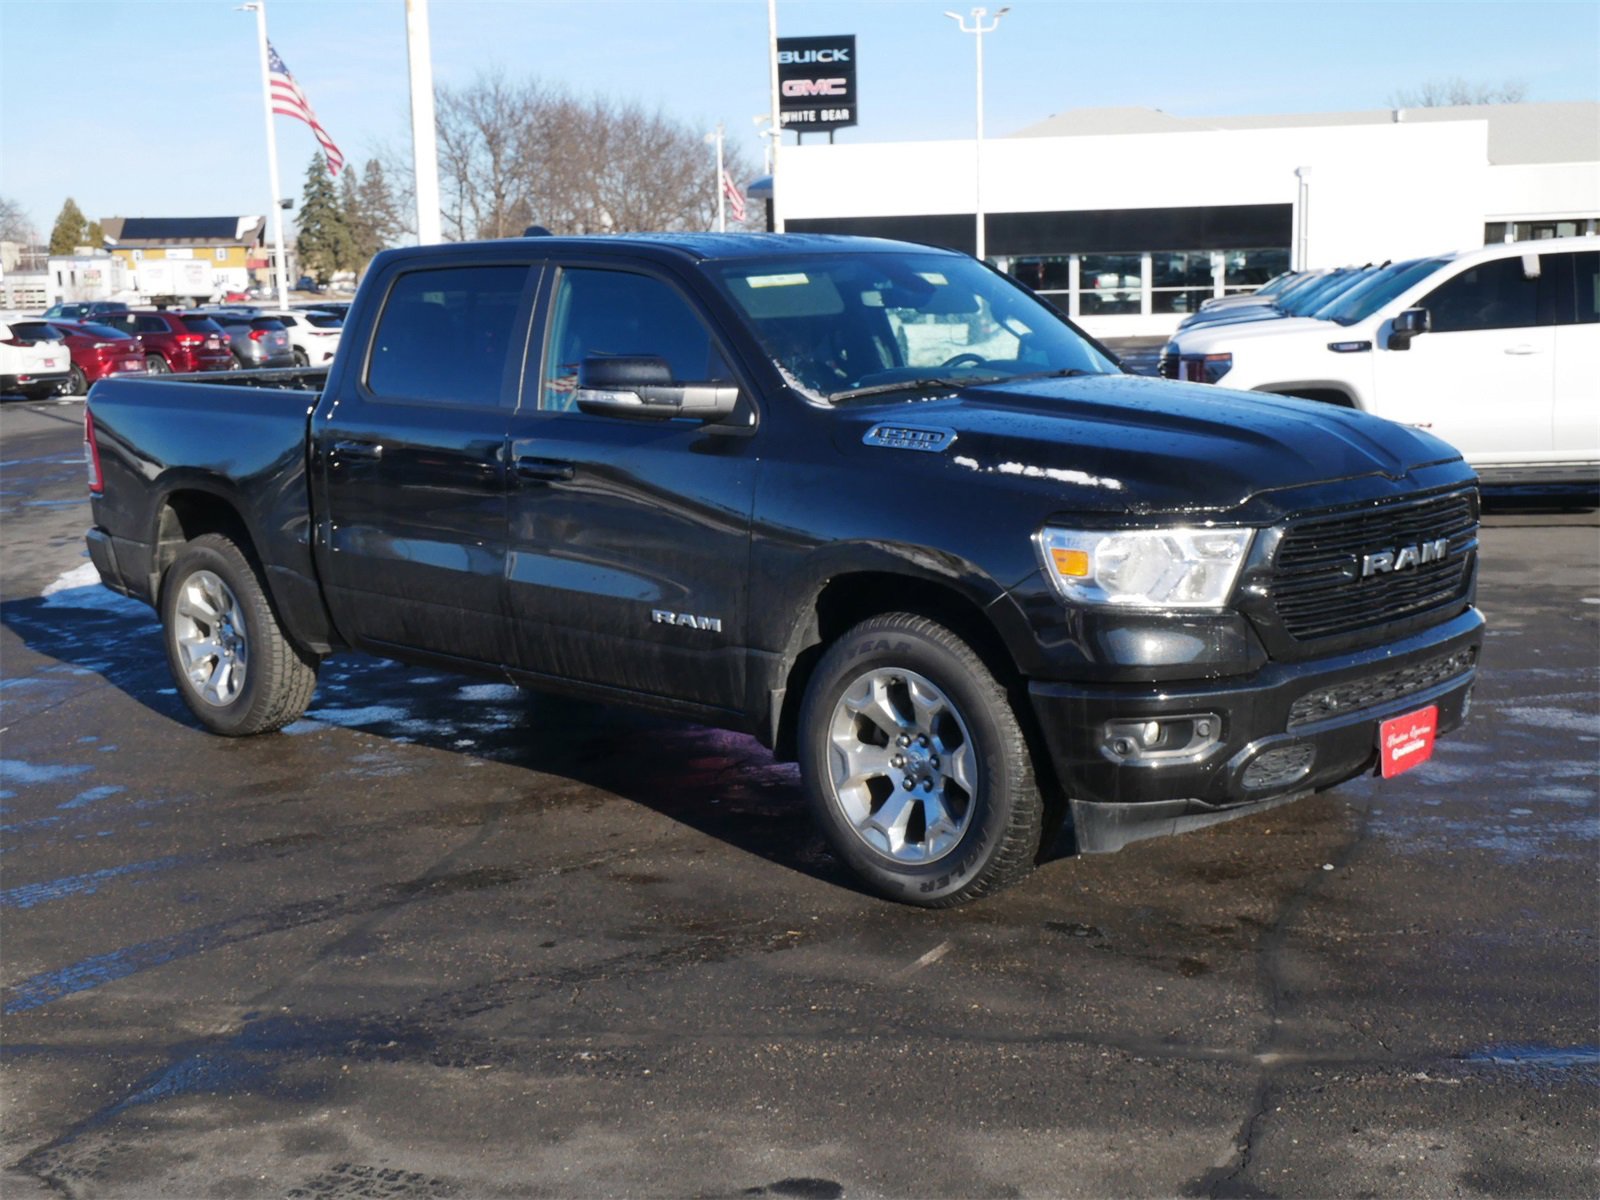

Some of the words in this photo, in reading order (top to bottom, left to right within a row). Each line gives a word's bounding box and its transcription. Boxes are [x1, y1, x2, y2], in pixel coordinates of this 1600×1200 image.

[777, 48, 850, 64] BUICK
[782, 78, 847, 97] GMC
[780, 110, 816, 124] WHITE
[820, 108, 850, 122] BEAR
[878, 428, 942, 443] 1500
[1362, 538, 1446, 577] RAM
[651, 609, 722, 632] RAM
